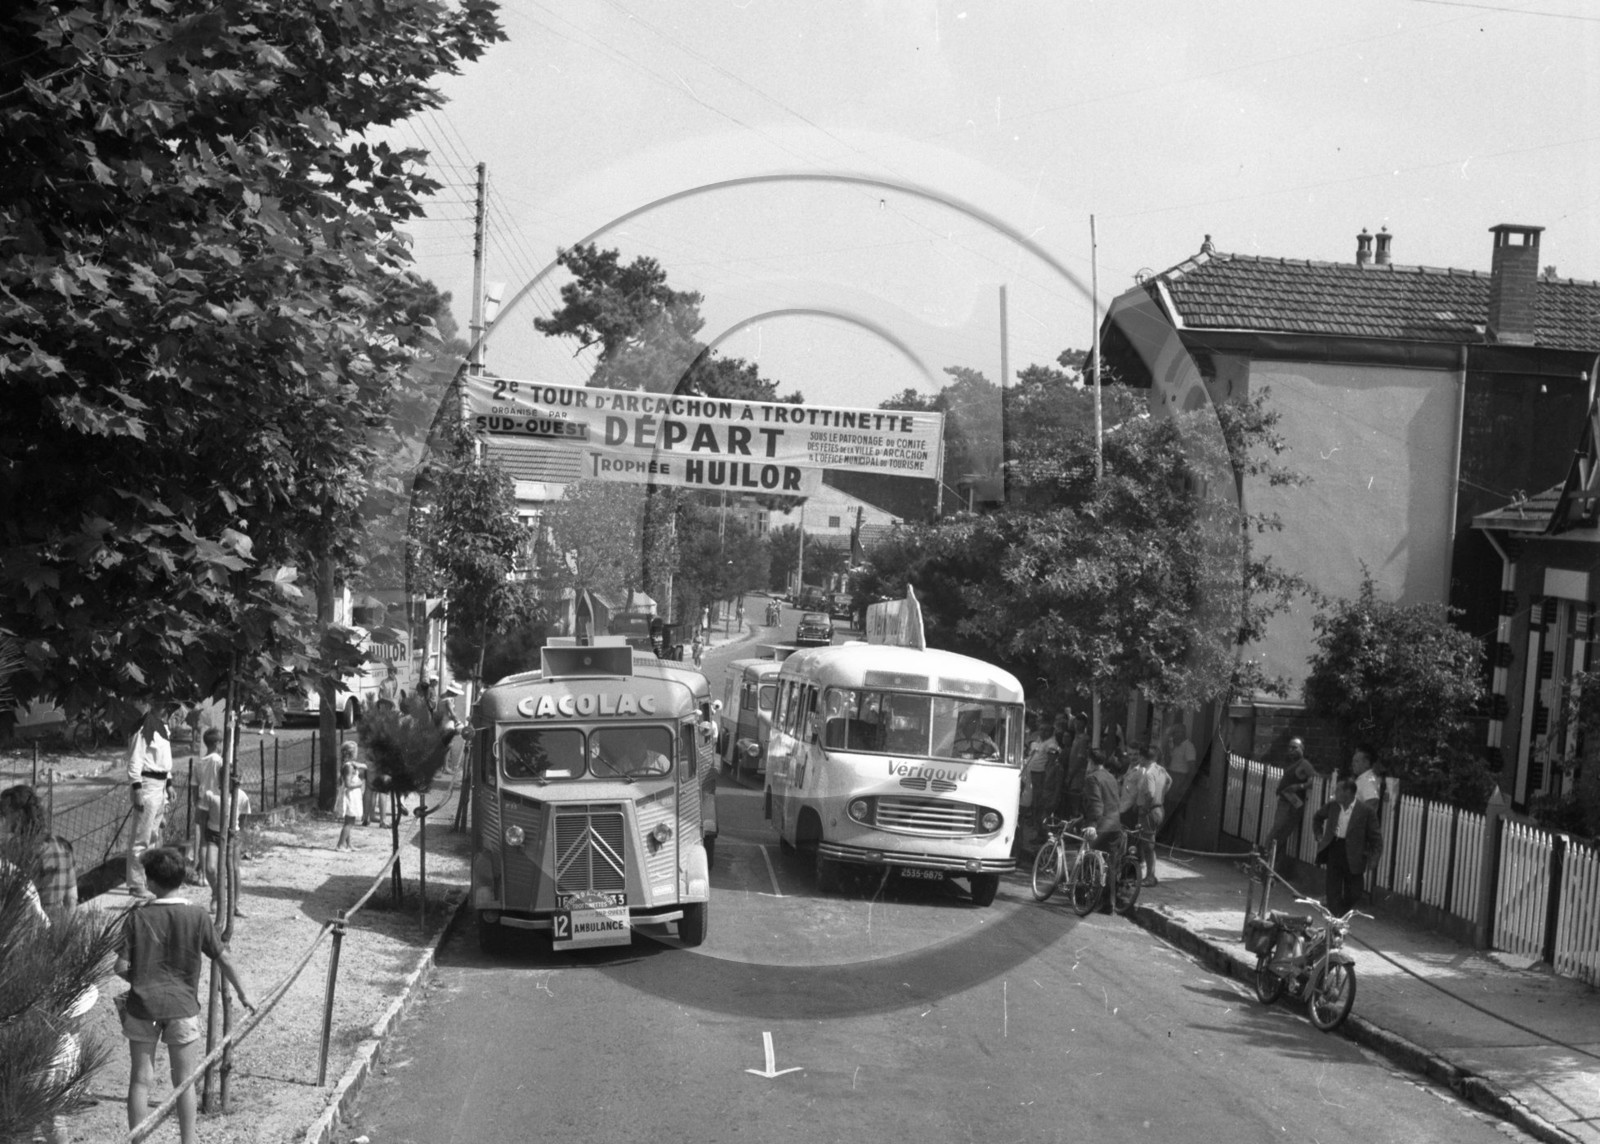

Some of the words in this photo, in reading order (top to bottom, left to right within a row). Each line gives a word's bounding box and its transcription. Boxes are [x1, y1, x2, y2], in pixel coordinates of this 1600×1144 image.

[531, 386, 588, 408] TOUR
[595, 394, 732, 419] D'ARCACHON
[761, 405, 913, 432] TROTTINETTE
[548, 410, 568, 418] PAR
[476, 415, 588, 436] SUD-OUEST
[605, 414, 785, 458] DÉPART
[807, 442, 819, 451] DES
[855, 446, 874, 456] VILLE
[810, 432, 827, 442] SOUS
[829, 433, 838, 442] LE
[839, 433, 883, 446] PATRONAGE
[886, 438, 895, 447] DU
[685, 458, 802, 491] HUILOR
[889, 459, 924, 471] TOURISME
[517, 693, 656, 718] CACOLAC
[554, 915, 568, 937] 12
[574, 921, 623, 933] AMBULANCE
